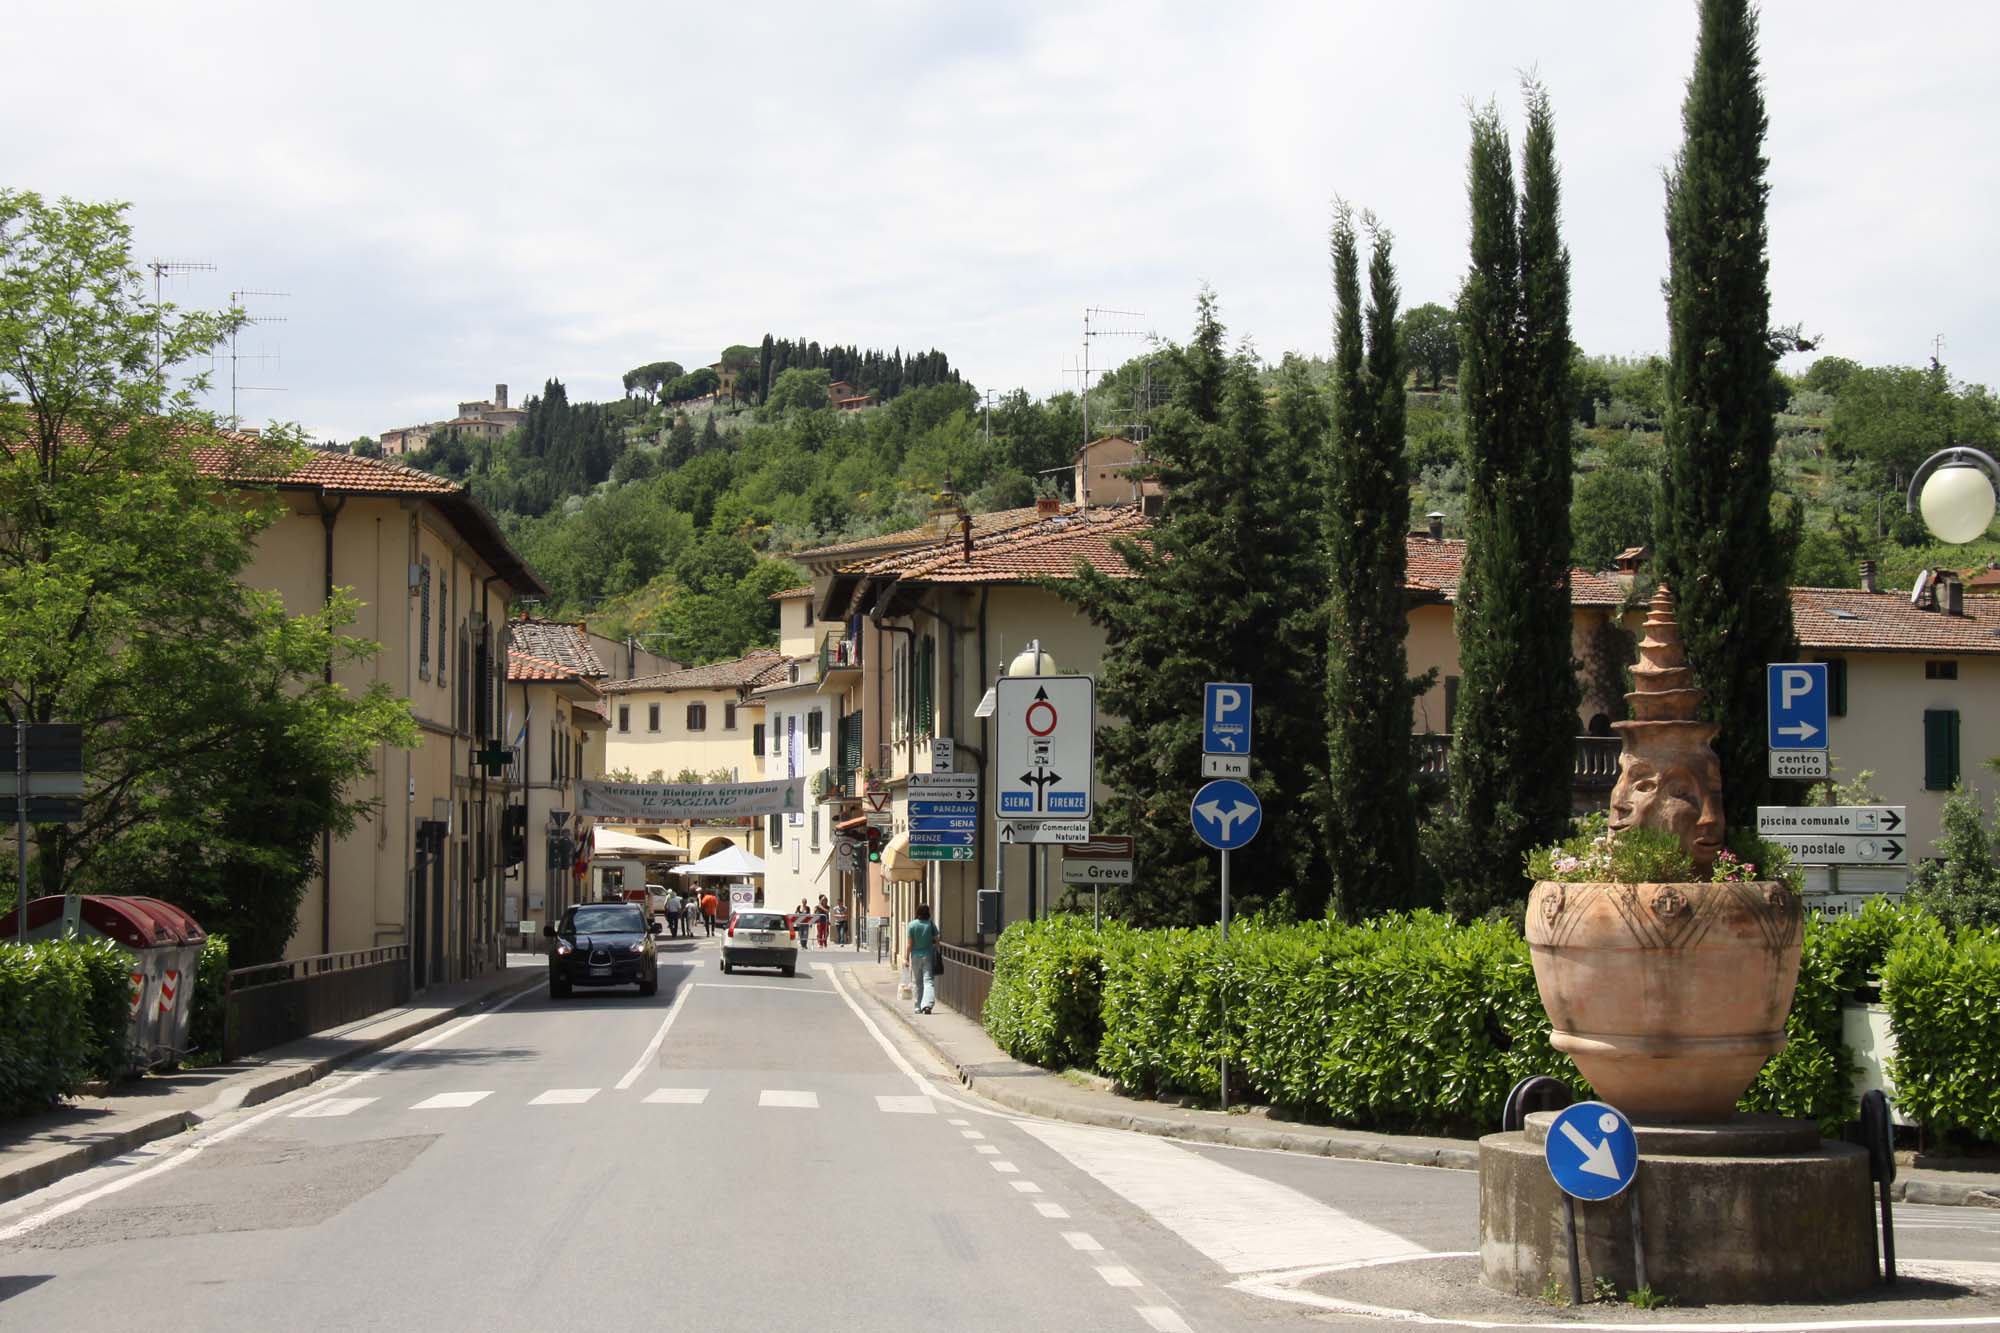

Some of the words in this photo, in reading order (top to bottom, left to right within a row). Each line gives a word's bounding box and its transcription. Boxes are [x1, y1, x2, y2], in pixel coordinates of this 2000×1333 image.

[1782, 670, 1813, 710] P
[1215, 689, 1241, 722] P
[1778, 754, 1819, 764] centro
[1211, 761, 1217, 772] 1
[1226, 763, 1241, 773] km
[1777, 765, 1821, 775] storico
[642, 797, 657, 807] IL
[660, 796, 738, 807] PAGLIAIO
[1004, 797, 1030, 808] SIENA
[1049, 797, 1084, 808] FIRENZE
[933, 805, 976, 813] PANZANO
[949, 819, 975, 827] SIENA
[1017, 823, 1040, 832] Centro
[1042, 823, 1086, 831] Commerciale
[1760, 816, 1797, 828] piscina
[1801, 816, 1850, 826] comunale
[910, 834, 942, 842] FIRENZE
[1055, 833, 1086, 841] Naturale
[1801, 842, 1846, 857] postale
[1088, 865, 1129, 879] Greve
